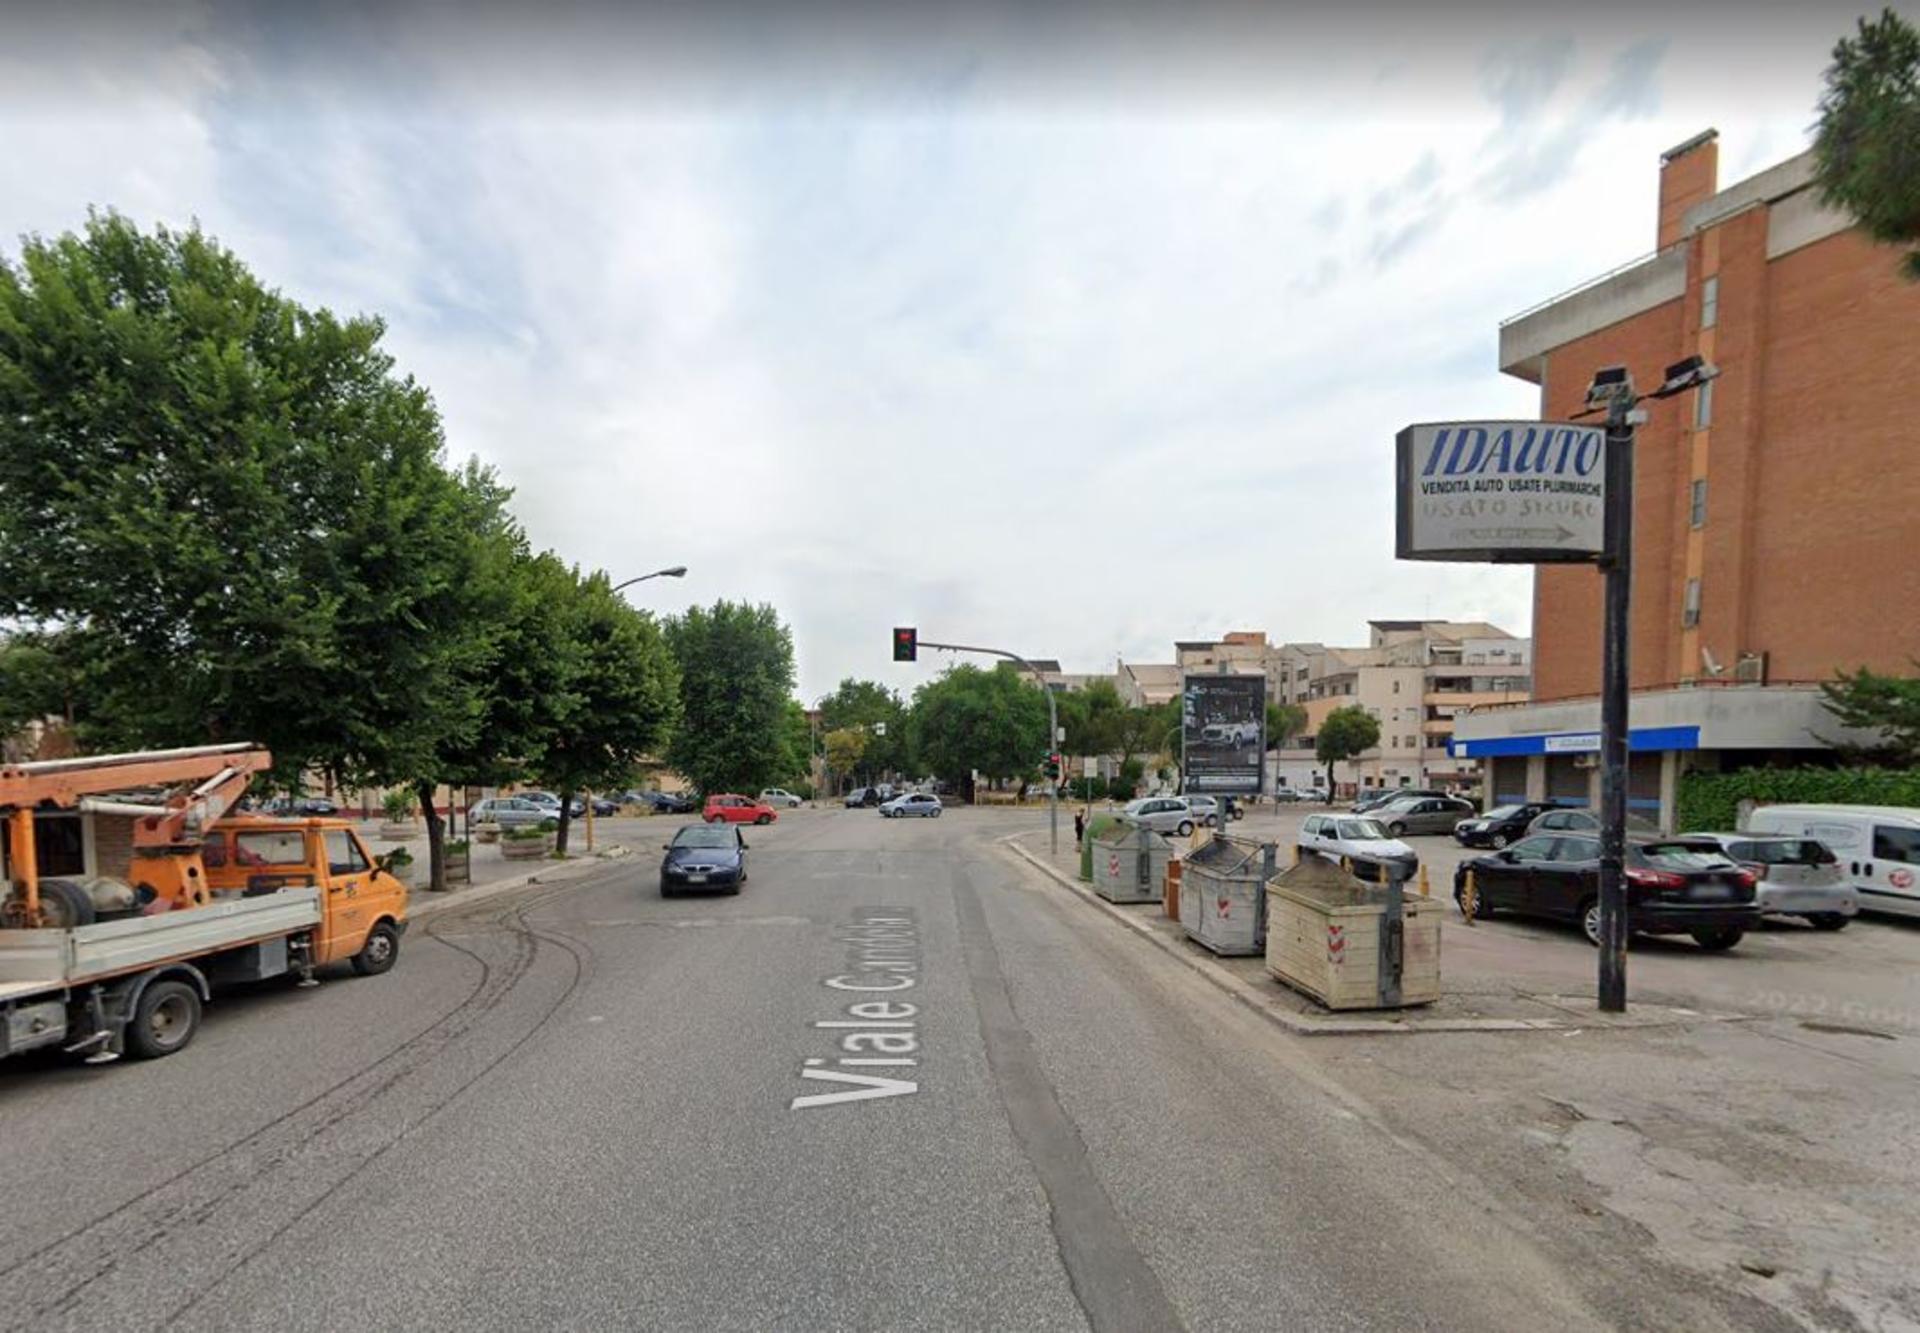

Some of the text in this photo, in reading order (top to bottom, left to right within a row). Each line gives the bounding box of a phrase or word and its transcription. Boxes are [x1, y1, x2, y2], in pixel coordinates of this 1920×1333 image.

[1421, 427, 1601, 476] IDAUTO
[1421, 479, 1471, 495] VENDITA
[1472, 479, 1503, 493] AUTO
[1508, 478, 1542, 493] USATE
